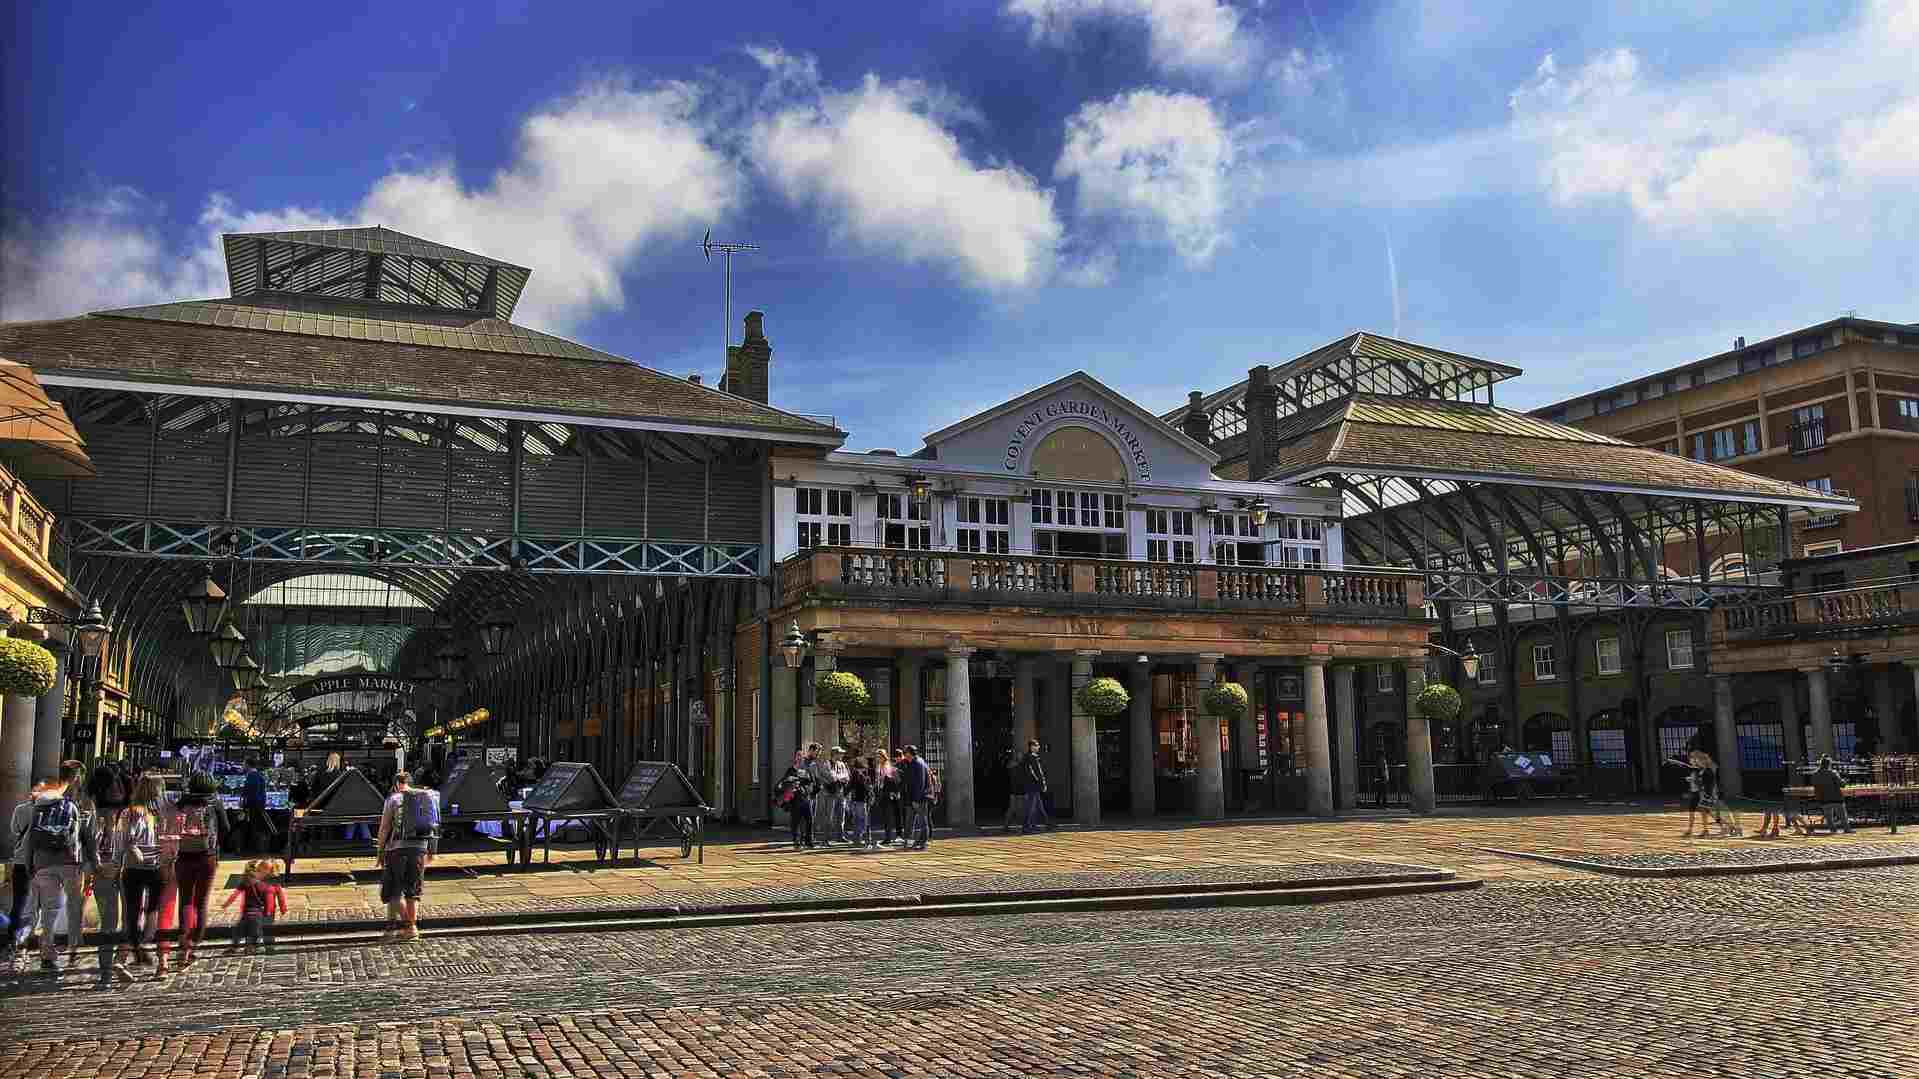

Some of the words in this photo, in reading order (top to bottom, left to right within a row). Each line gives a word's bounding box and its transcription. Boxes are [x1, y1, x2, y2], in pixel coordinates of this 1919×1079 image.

[1004, 410, 1043, 470] COVENT
[1046, 400, 1109, 424] GARDEN
[1109, 417, 1151, 481] MARKET
[311, 679, 352, 693] APPLE
[358, 678, 416, 694] MARKET
